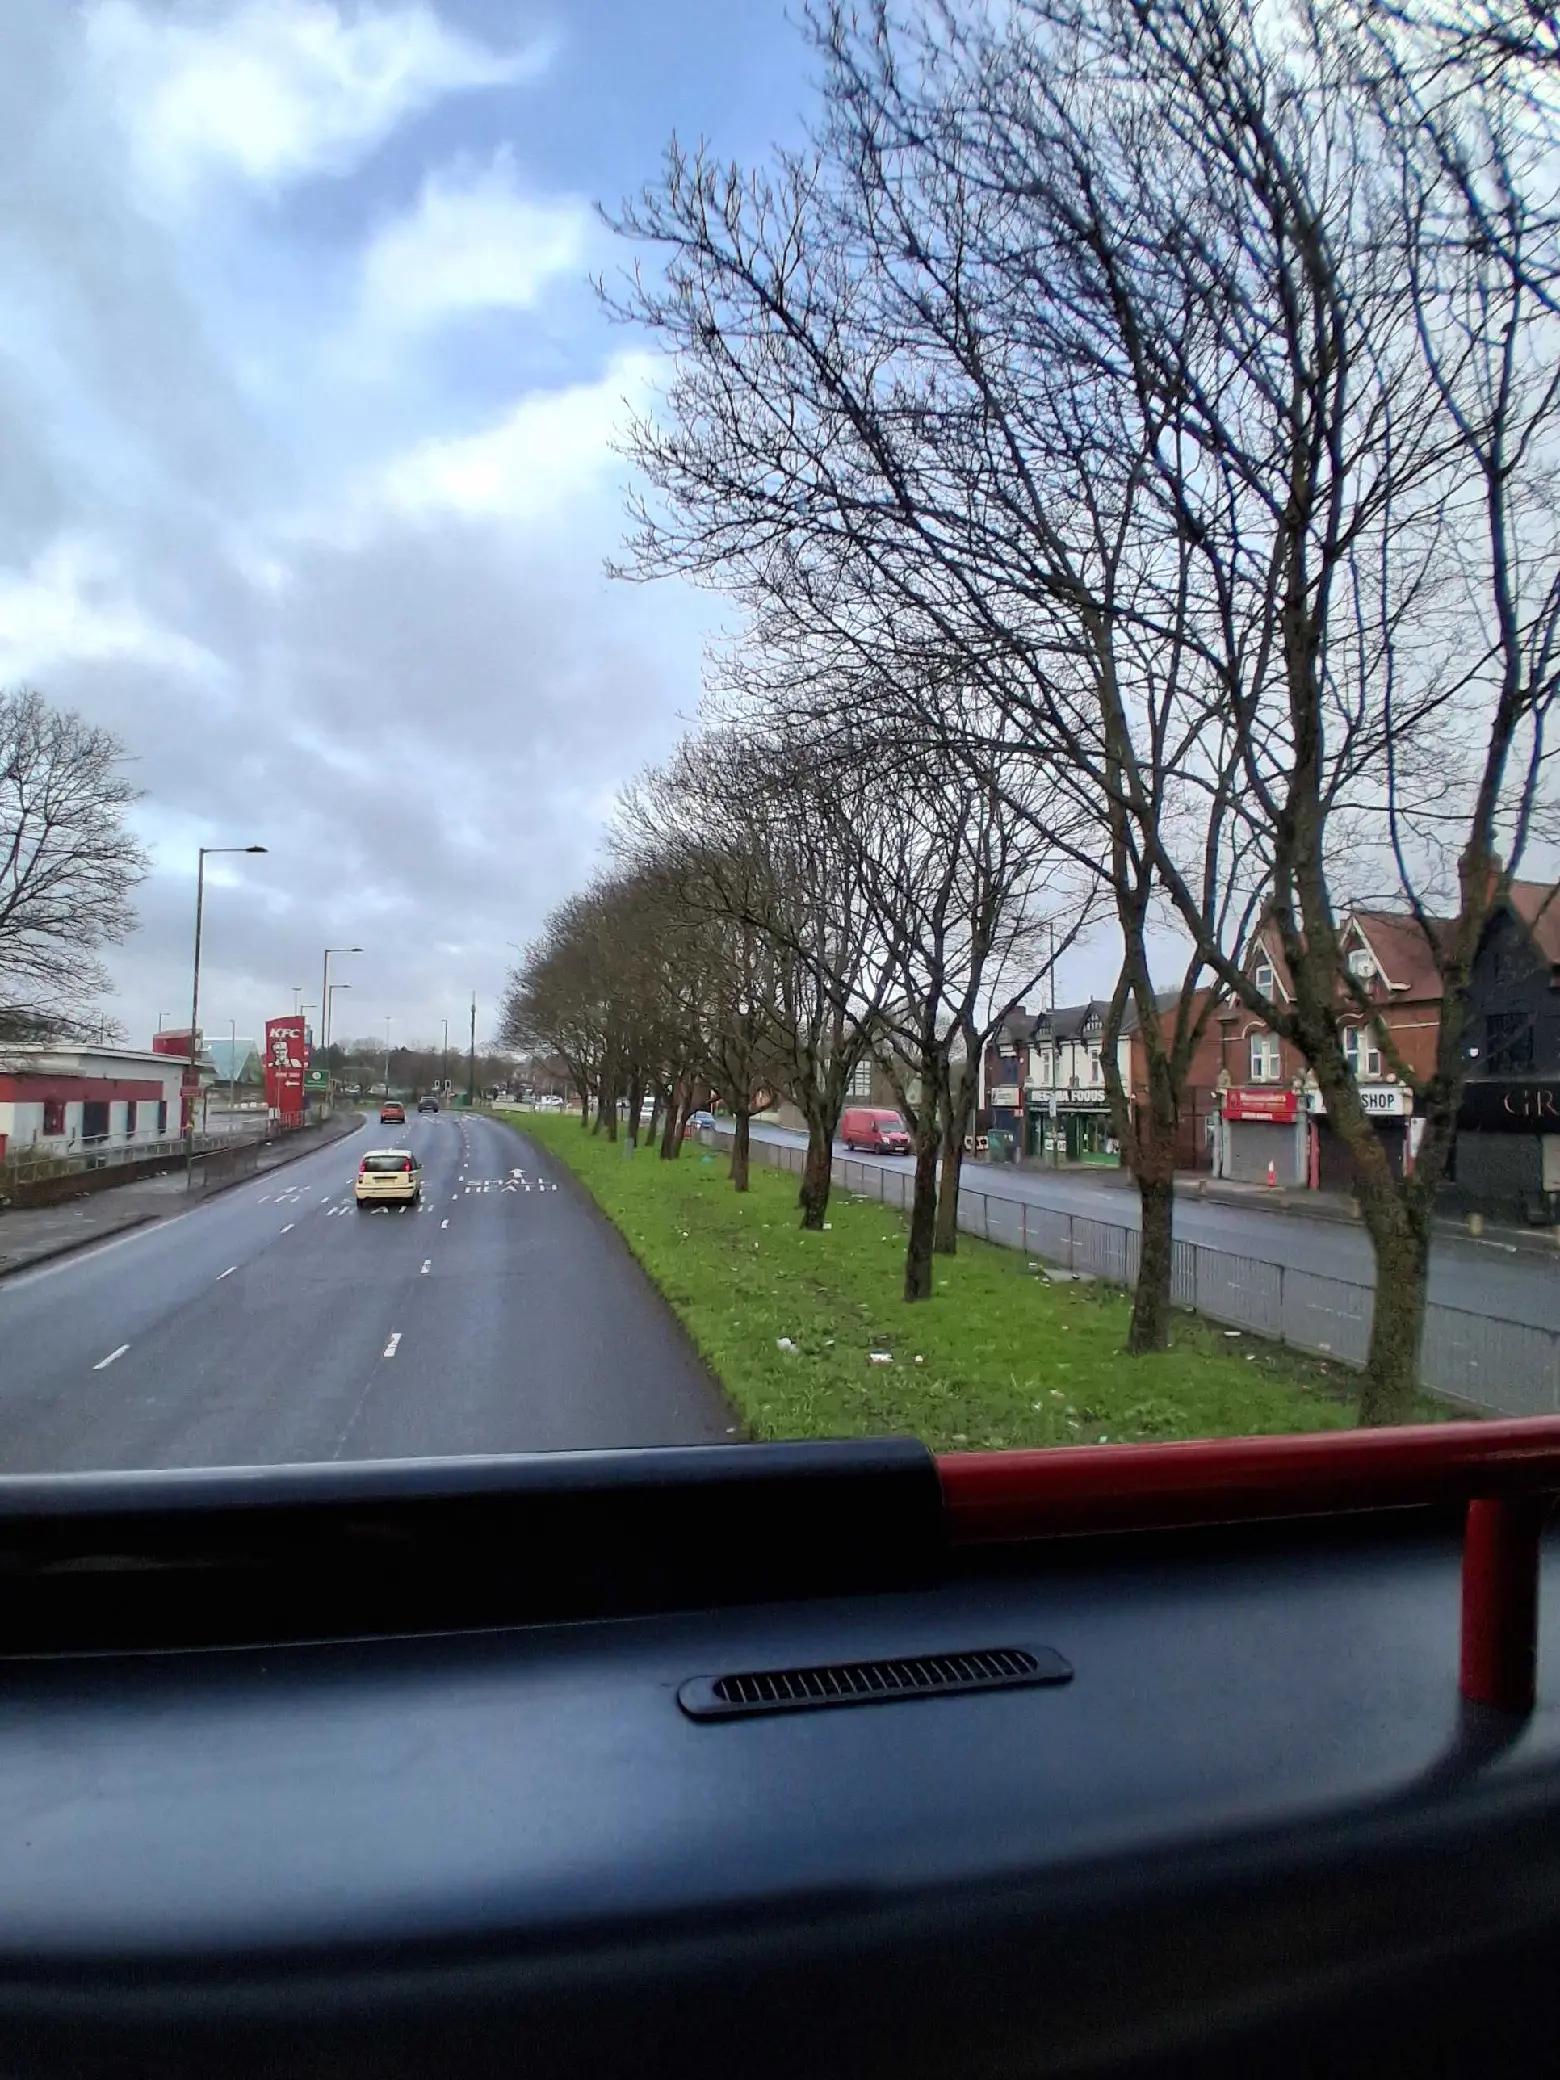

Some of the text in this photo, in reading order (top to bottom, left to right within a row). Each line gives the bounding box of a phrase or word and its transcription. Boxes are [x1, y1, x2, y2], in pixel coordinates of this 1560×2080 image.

[269, 1028, 301, 1038] KFC
[1071, 1090, 1106, 1102] FOODS
[1361, 1093, 1395, 1109] SHOP
